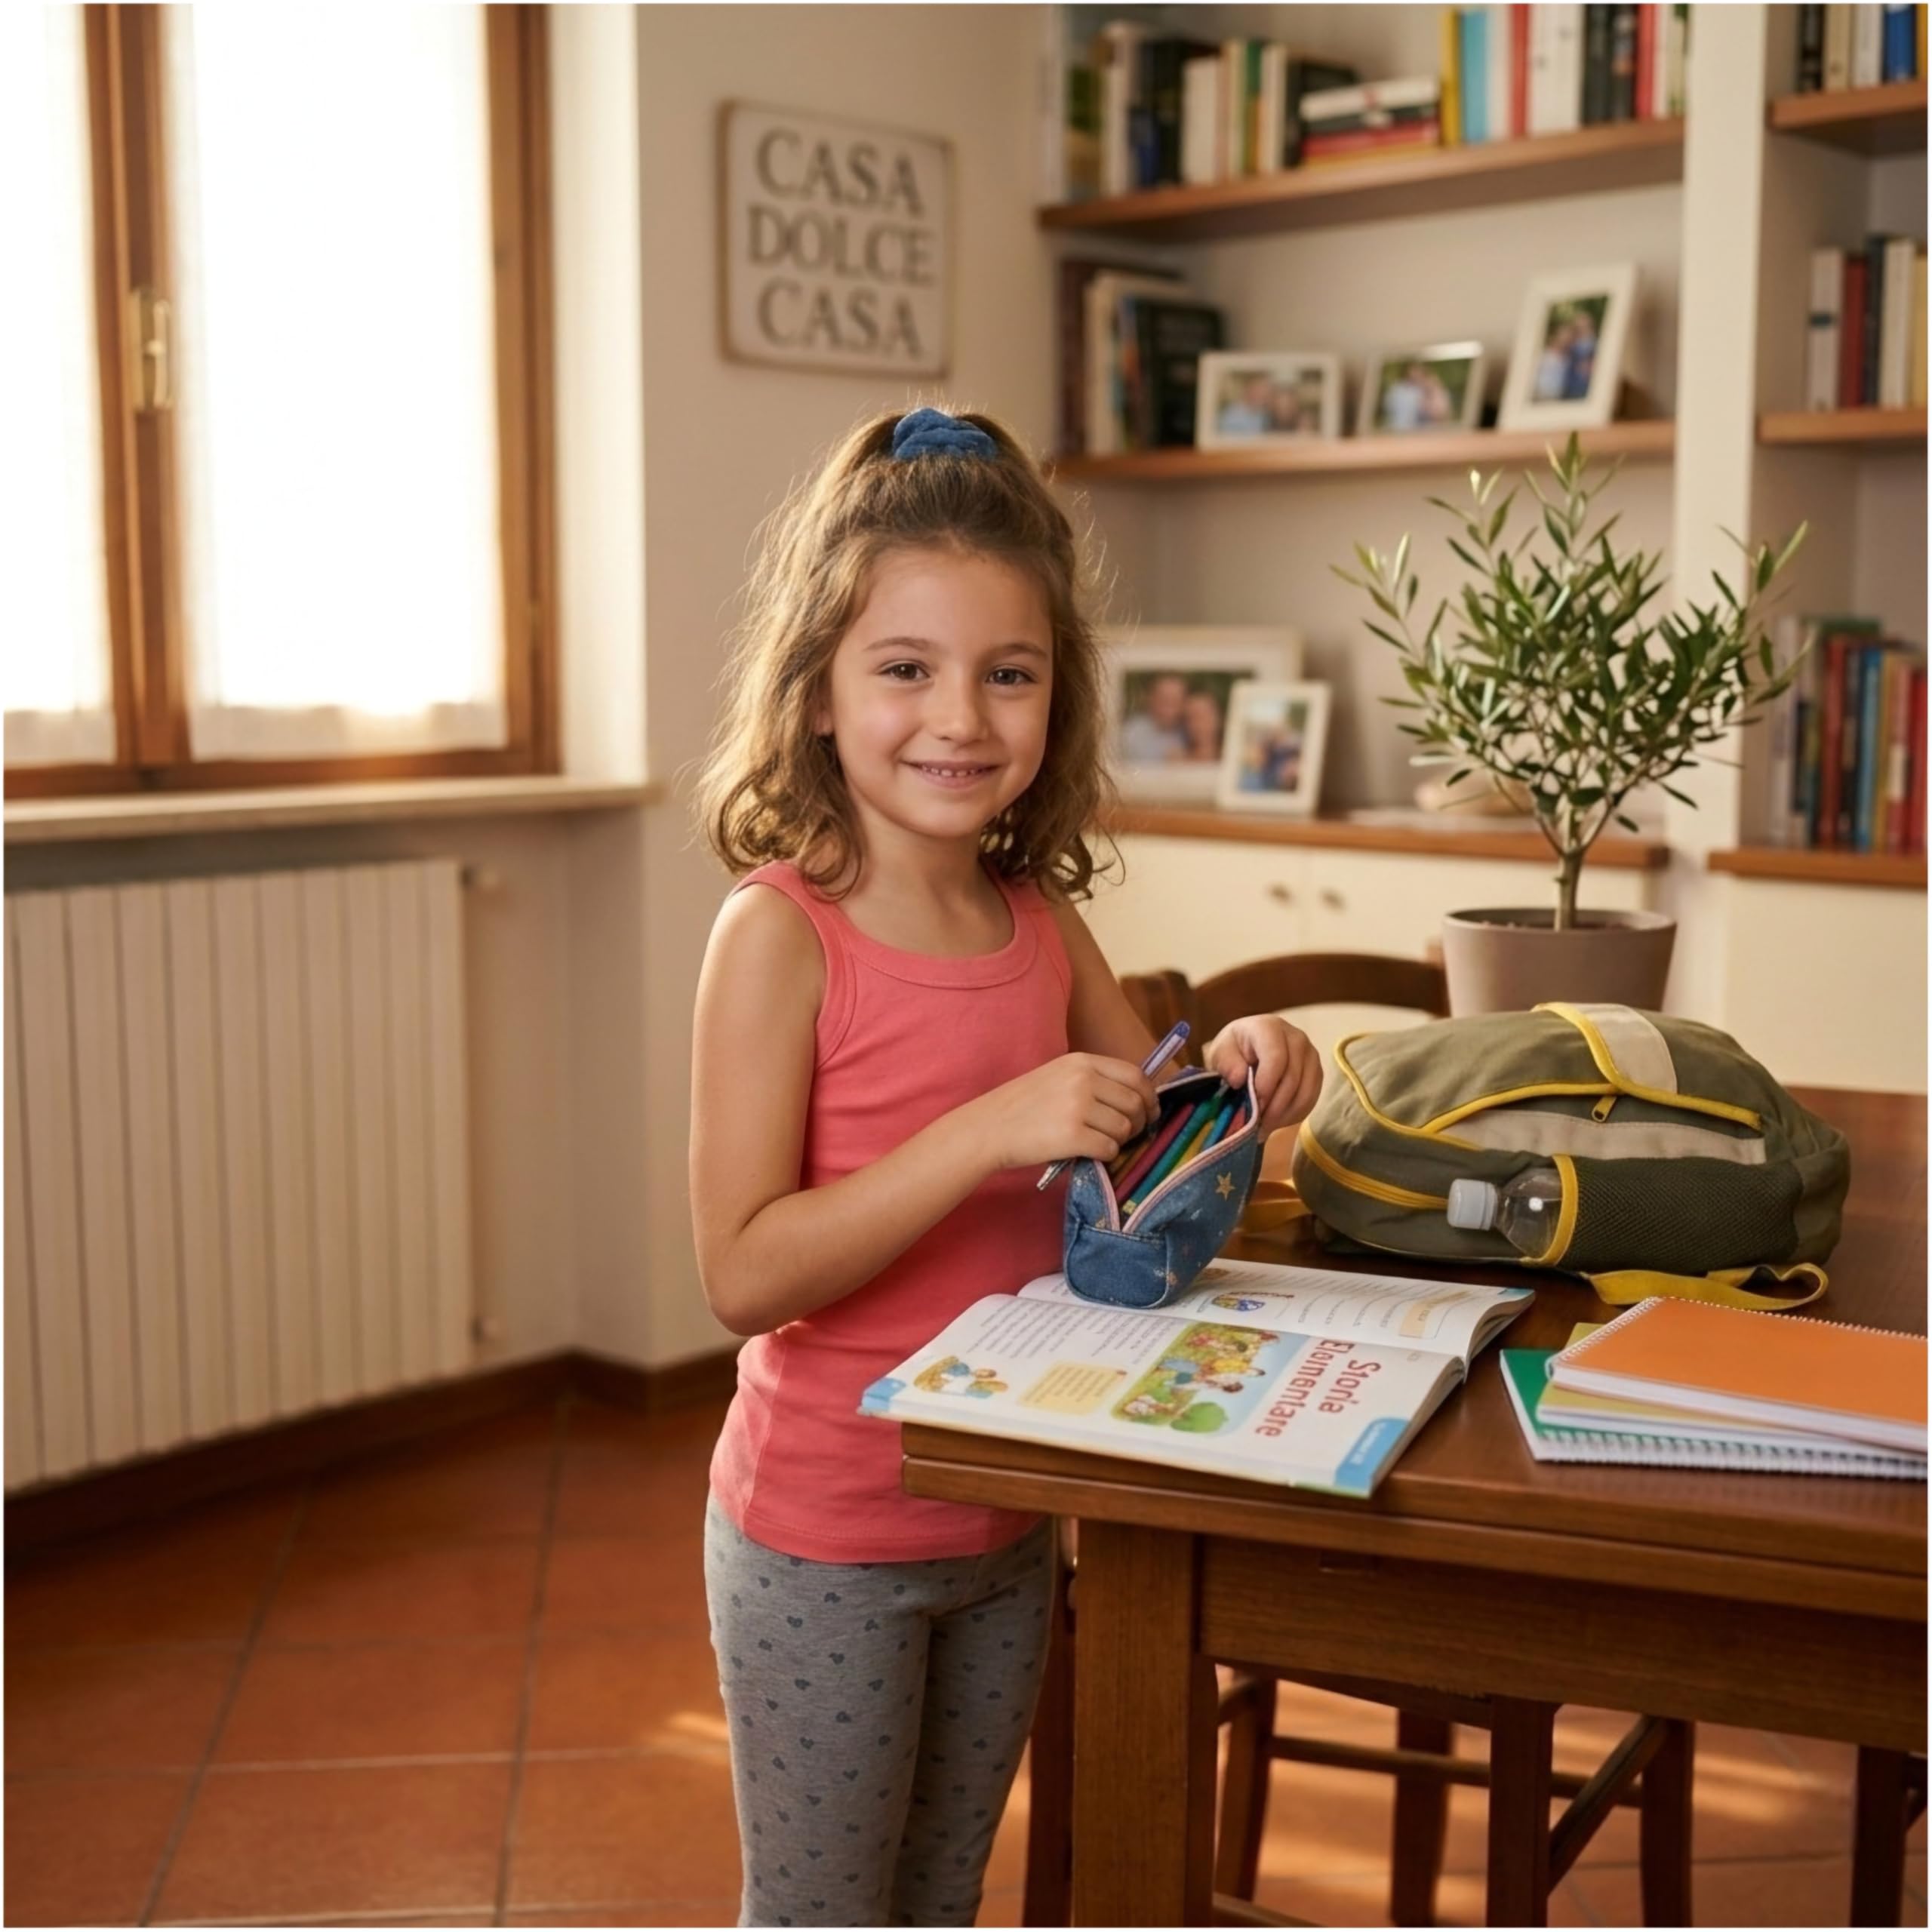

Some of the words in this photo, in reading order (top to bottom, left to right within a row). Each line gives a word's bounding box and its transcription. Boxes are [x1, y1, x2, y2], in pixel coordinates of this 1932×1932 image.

[756, 127, 924, 219] CASA
[747, 202, 936, 288] DOLCE
[756, 276, 922, 360] CASA
[1318, 1359, 1382, 1414] Storia
